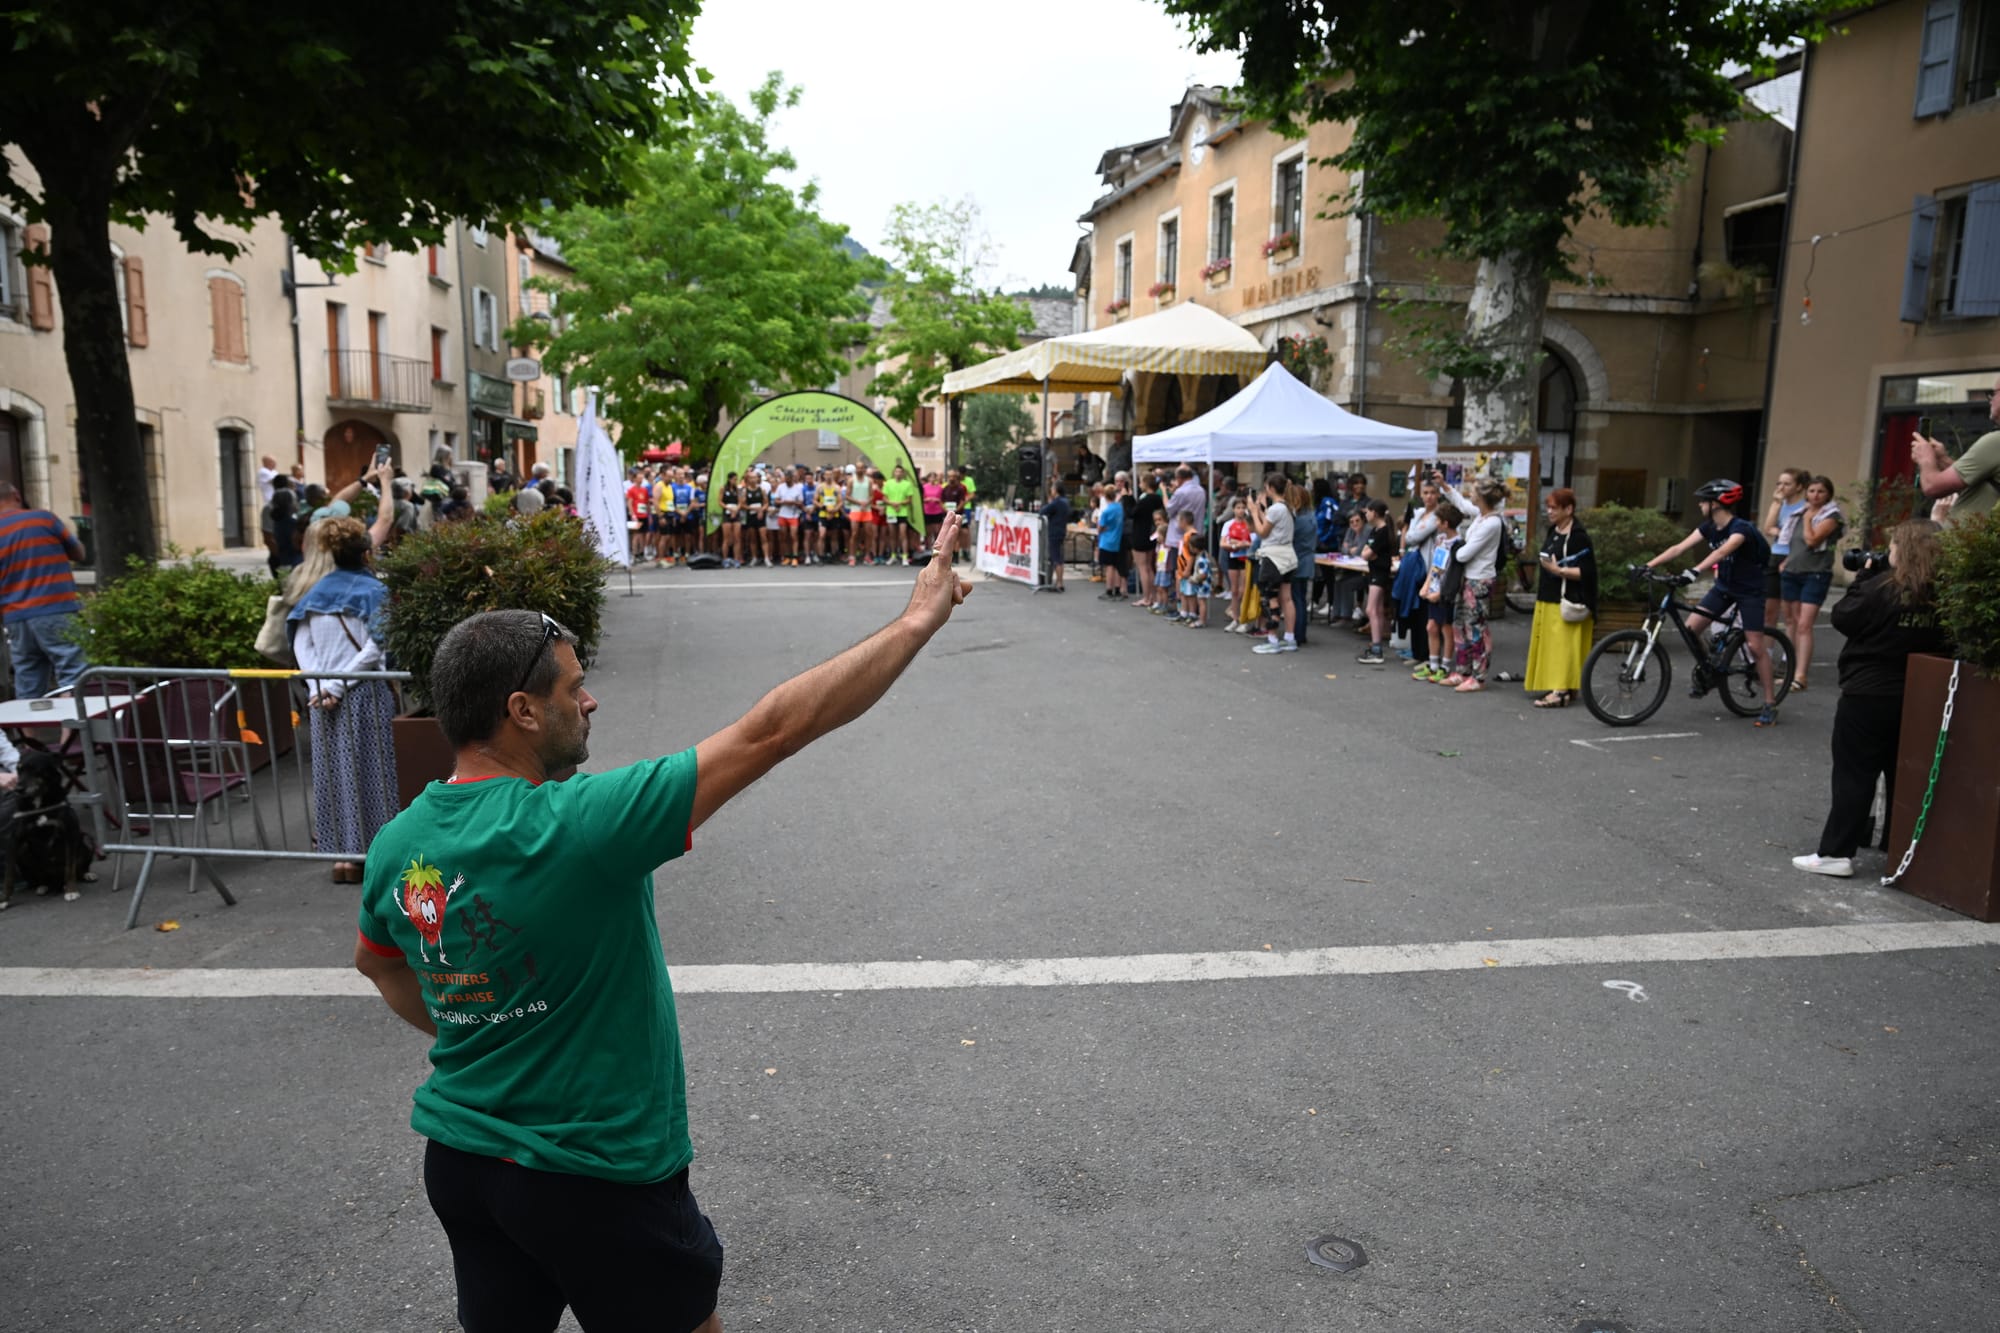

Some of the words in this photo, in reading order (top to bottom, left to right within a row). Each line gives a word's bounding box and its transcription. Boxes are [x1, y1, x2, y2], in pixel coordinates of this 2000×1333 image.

[1242, 266, 1323, 306] MAIRIE
[431, 973, 490, 985] SENTIERS
[447, 992, 496, 1004] FRAISE
[527, 1000, 548, 1013] 48
